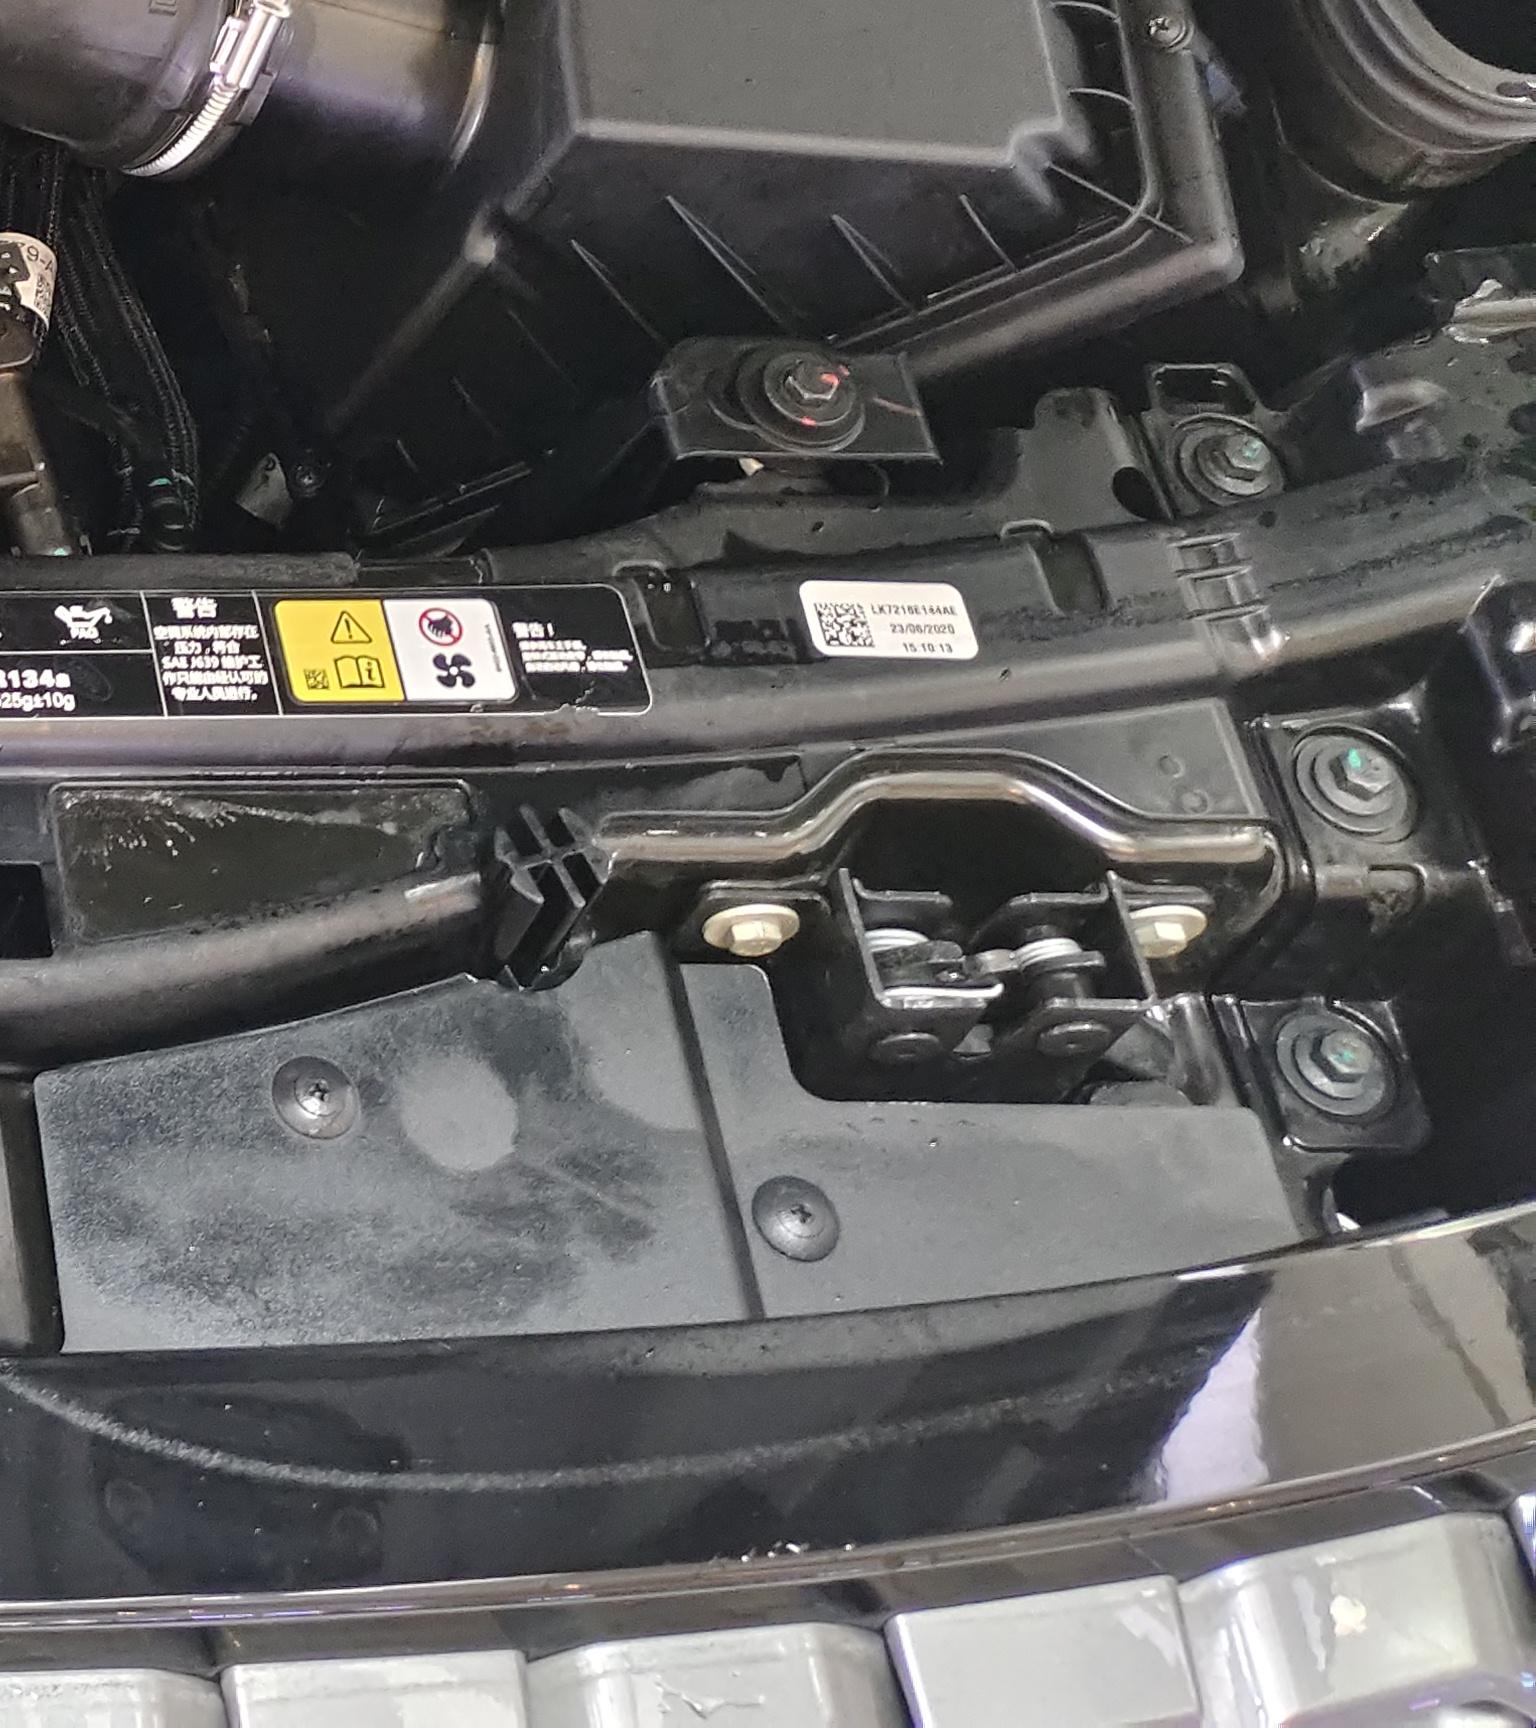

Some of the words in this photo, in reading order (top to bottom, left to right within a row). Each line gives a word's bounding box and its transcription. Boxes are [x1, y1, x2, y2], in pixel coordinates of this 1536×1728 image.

[171, 597, 218, 619] 警告
[889, 623, 955, 635] 23/06/2020
[161, 656, 188, 670] SAE
